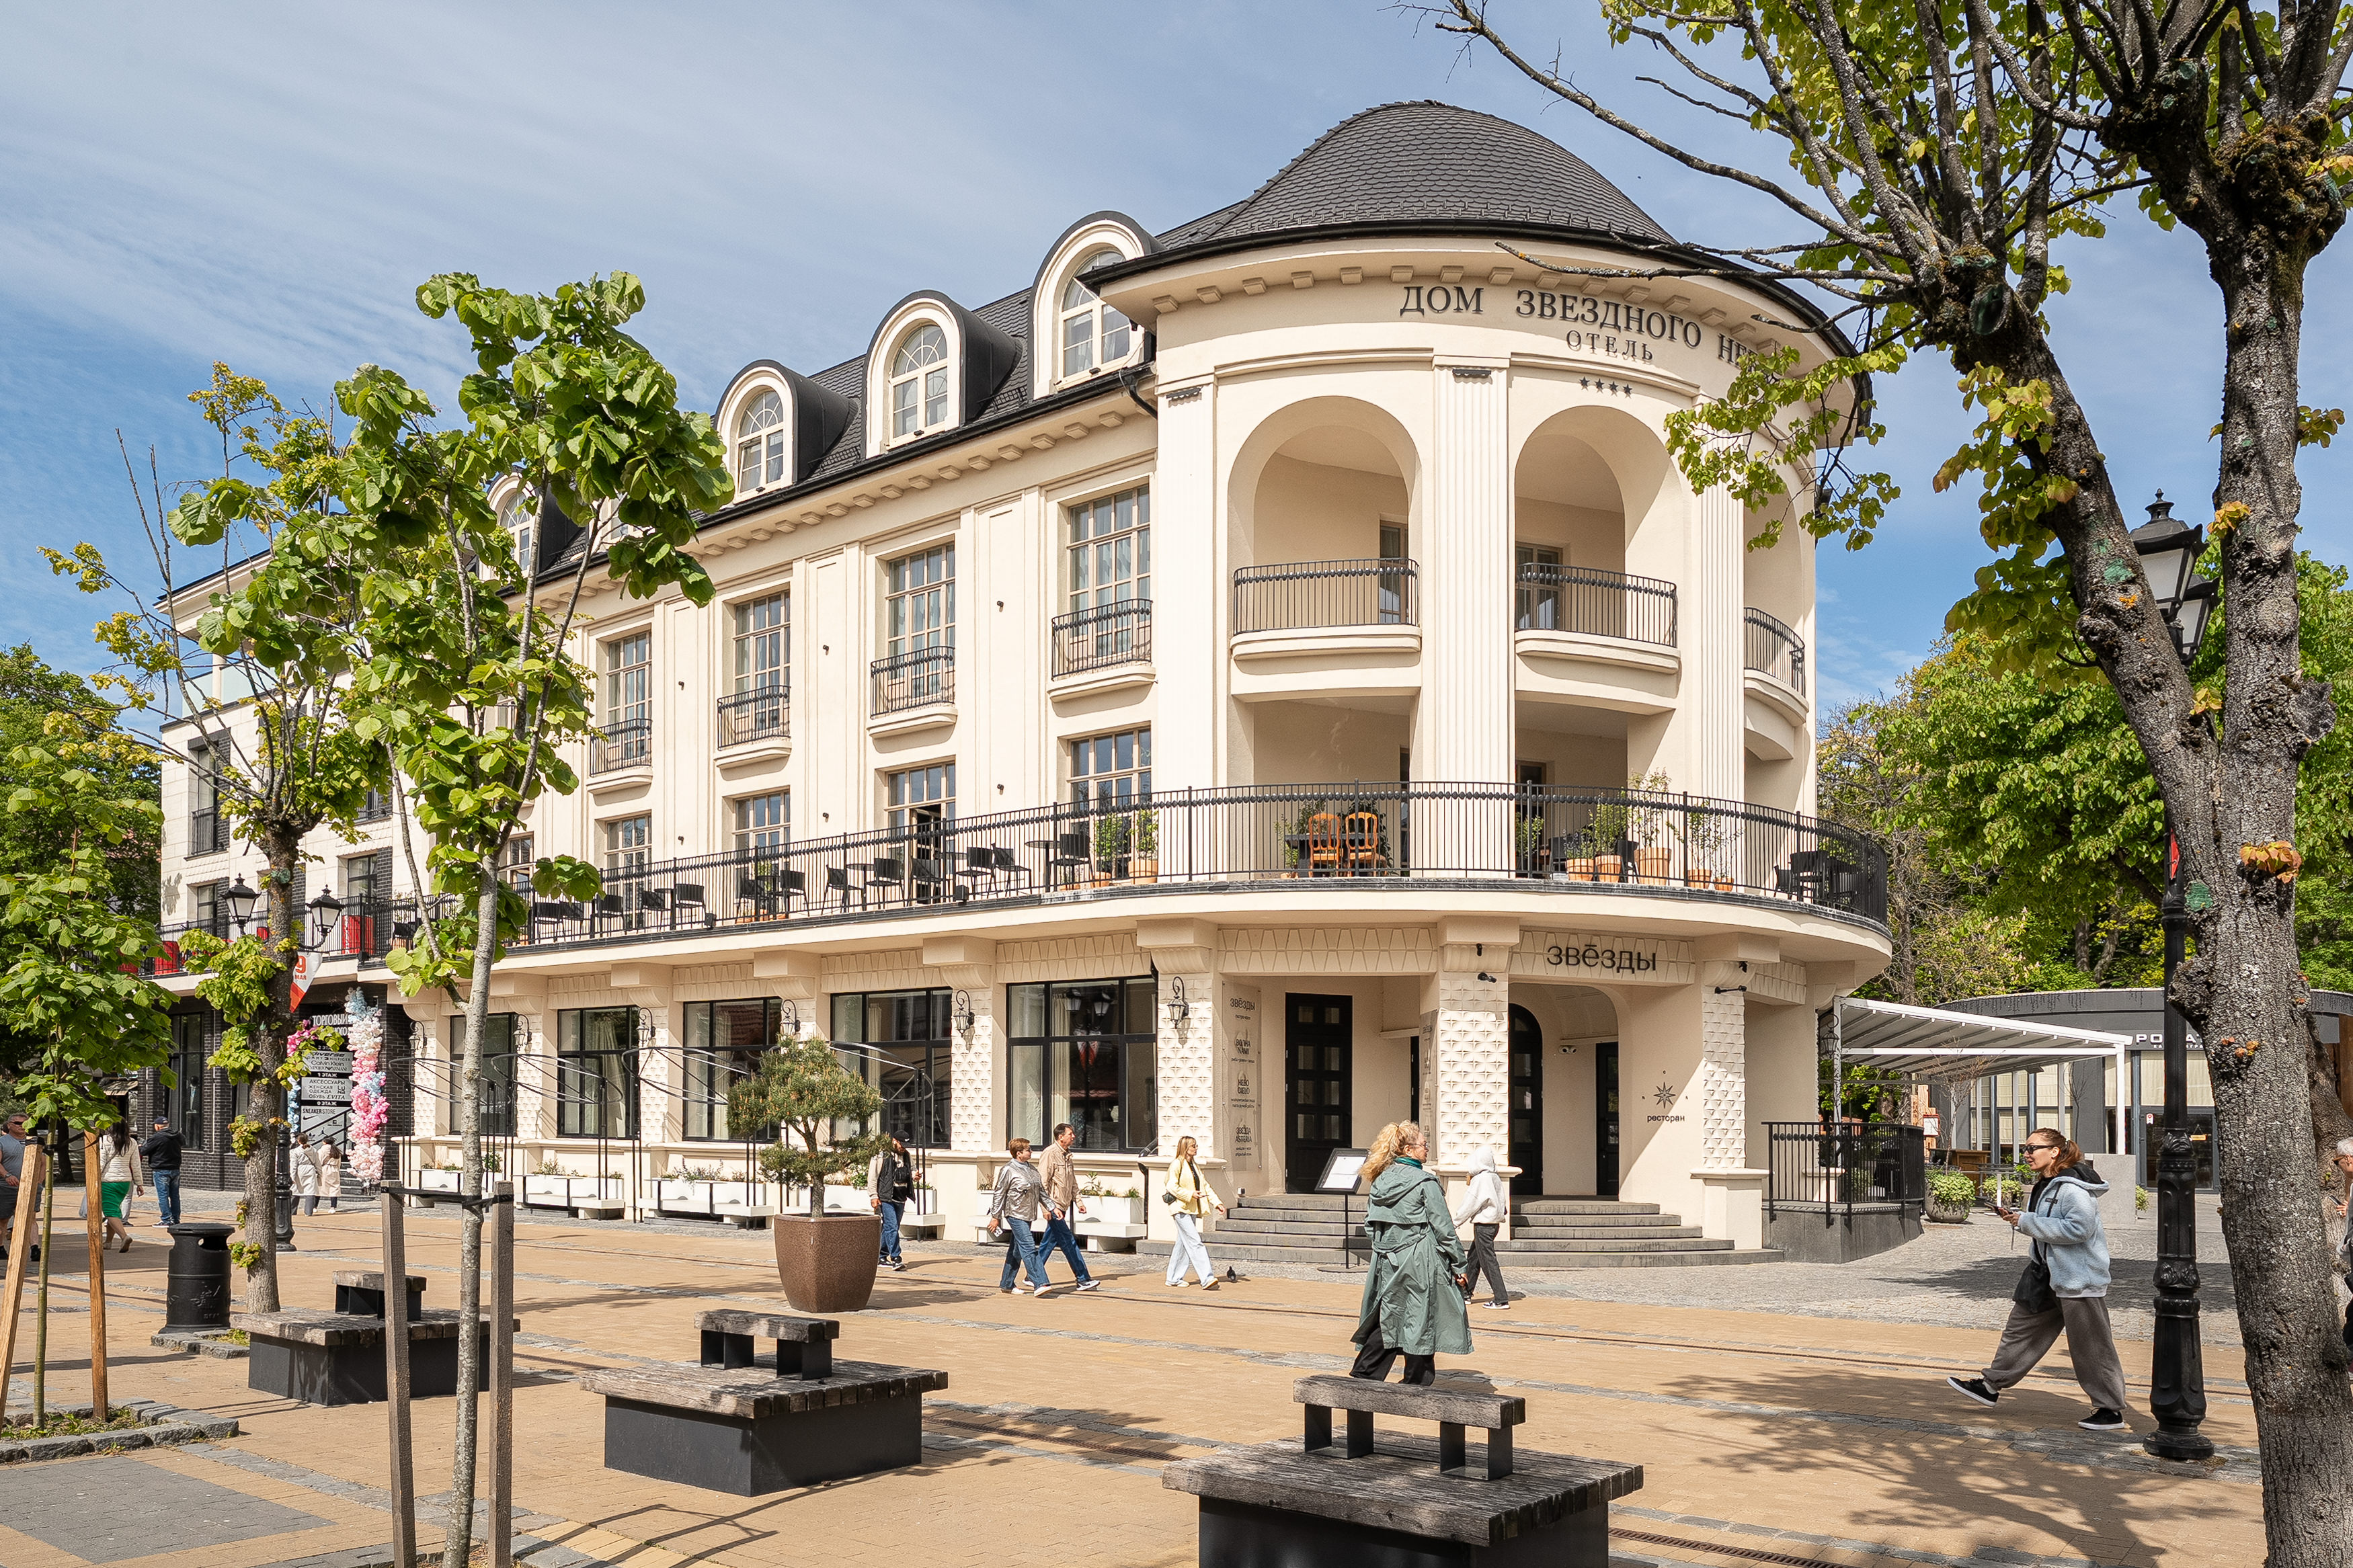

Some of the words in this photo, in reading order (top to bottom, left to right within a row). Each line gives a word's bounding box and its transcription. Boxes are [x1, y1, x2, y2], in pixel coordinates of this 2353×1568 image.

[1400, 286, 1483, 317] ДОМ
[1516, 290, 1702, 348] ЗВЕЗДНОГО
[1566, 330, 1653, 361] ОТЕЛЬ
[1647, 1114, 1685, 1124] ресторан
